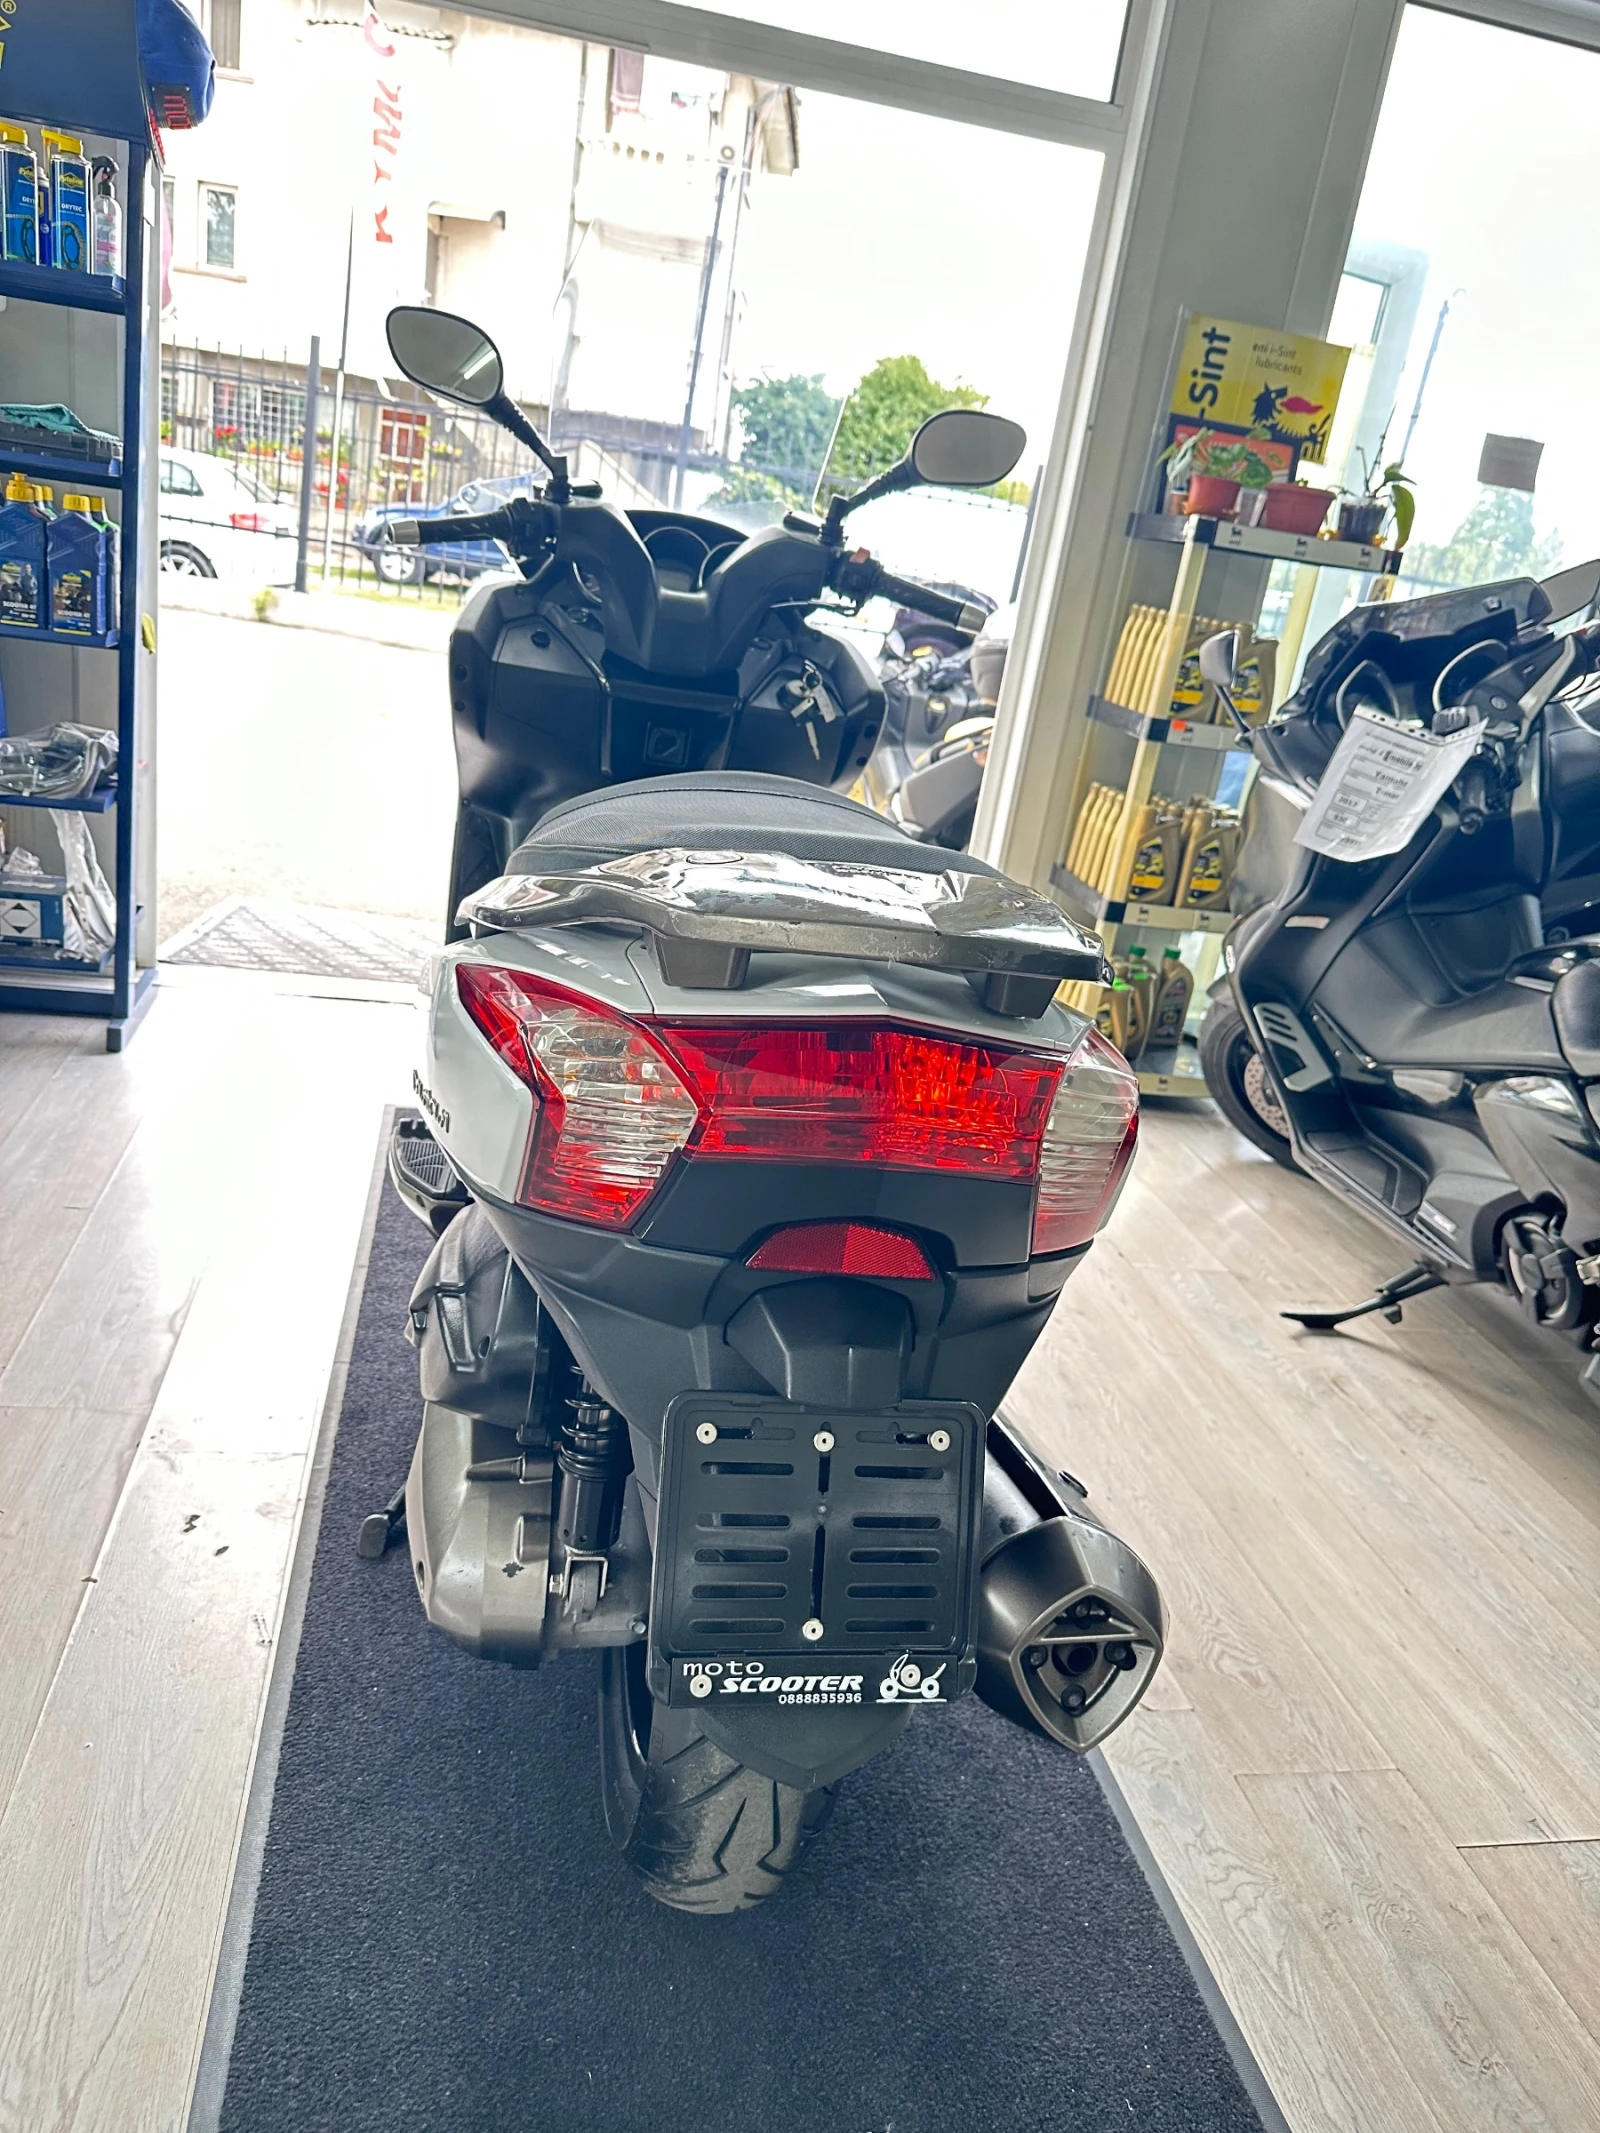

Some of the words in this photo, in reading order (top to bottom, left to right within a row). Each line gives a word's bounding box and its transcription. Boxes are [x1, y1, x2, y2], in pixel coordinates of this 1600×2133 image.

[61, 202, 83, 213] DRYTEC
[1255, 356, 1303, 376] lubricants
[682, 1660, 765, 1677] moto
[719, 1674, 864, 1694] SCOOTER
[778, 1692, 862, 1705] 0888835936
